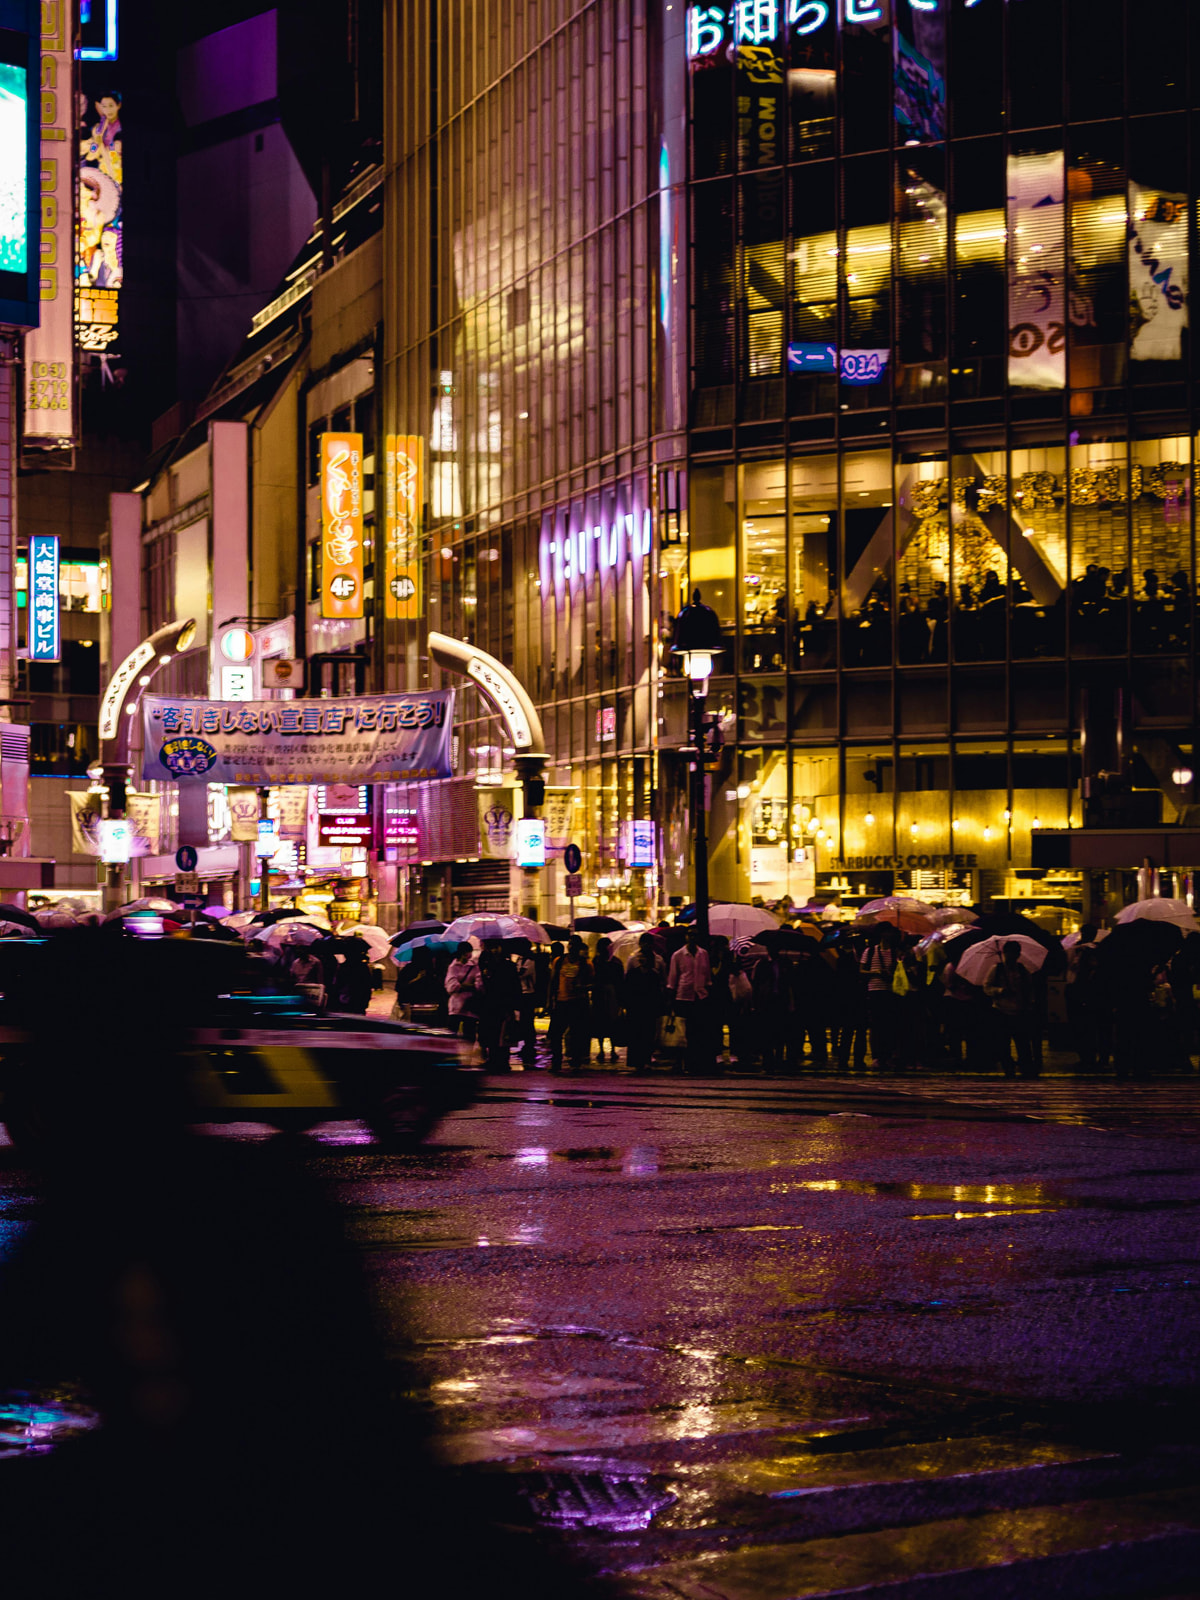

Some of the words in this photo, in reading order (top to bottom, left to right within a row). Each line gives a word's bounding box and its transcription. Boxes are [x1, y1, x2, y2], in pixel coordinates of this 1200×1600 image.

[31, 362, 66, 379] (03)
[29, 380, 69, 395] 3719
[29, 395, 69, 410] 2468
[911, 460, 1200, 518] STARBUC
[330, 578, 355, 596] 4F
[830, 856, 904, 869] STARBUCKS
[906, 854, 977, 868] COFFEE
